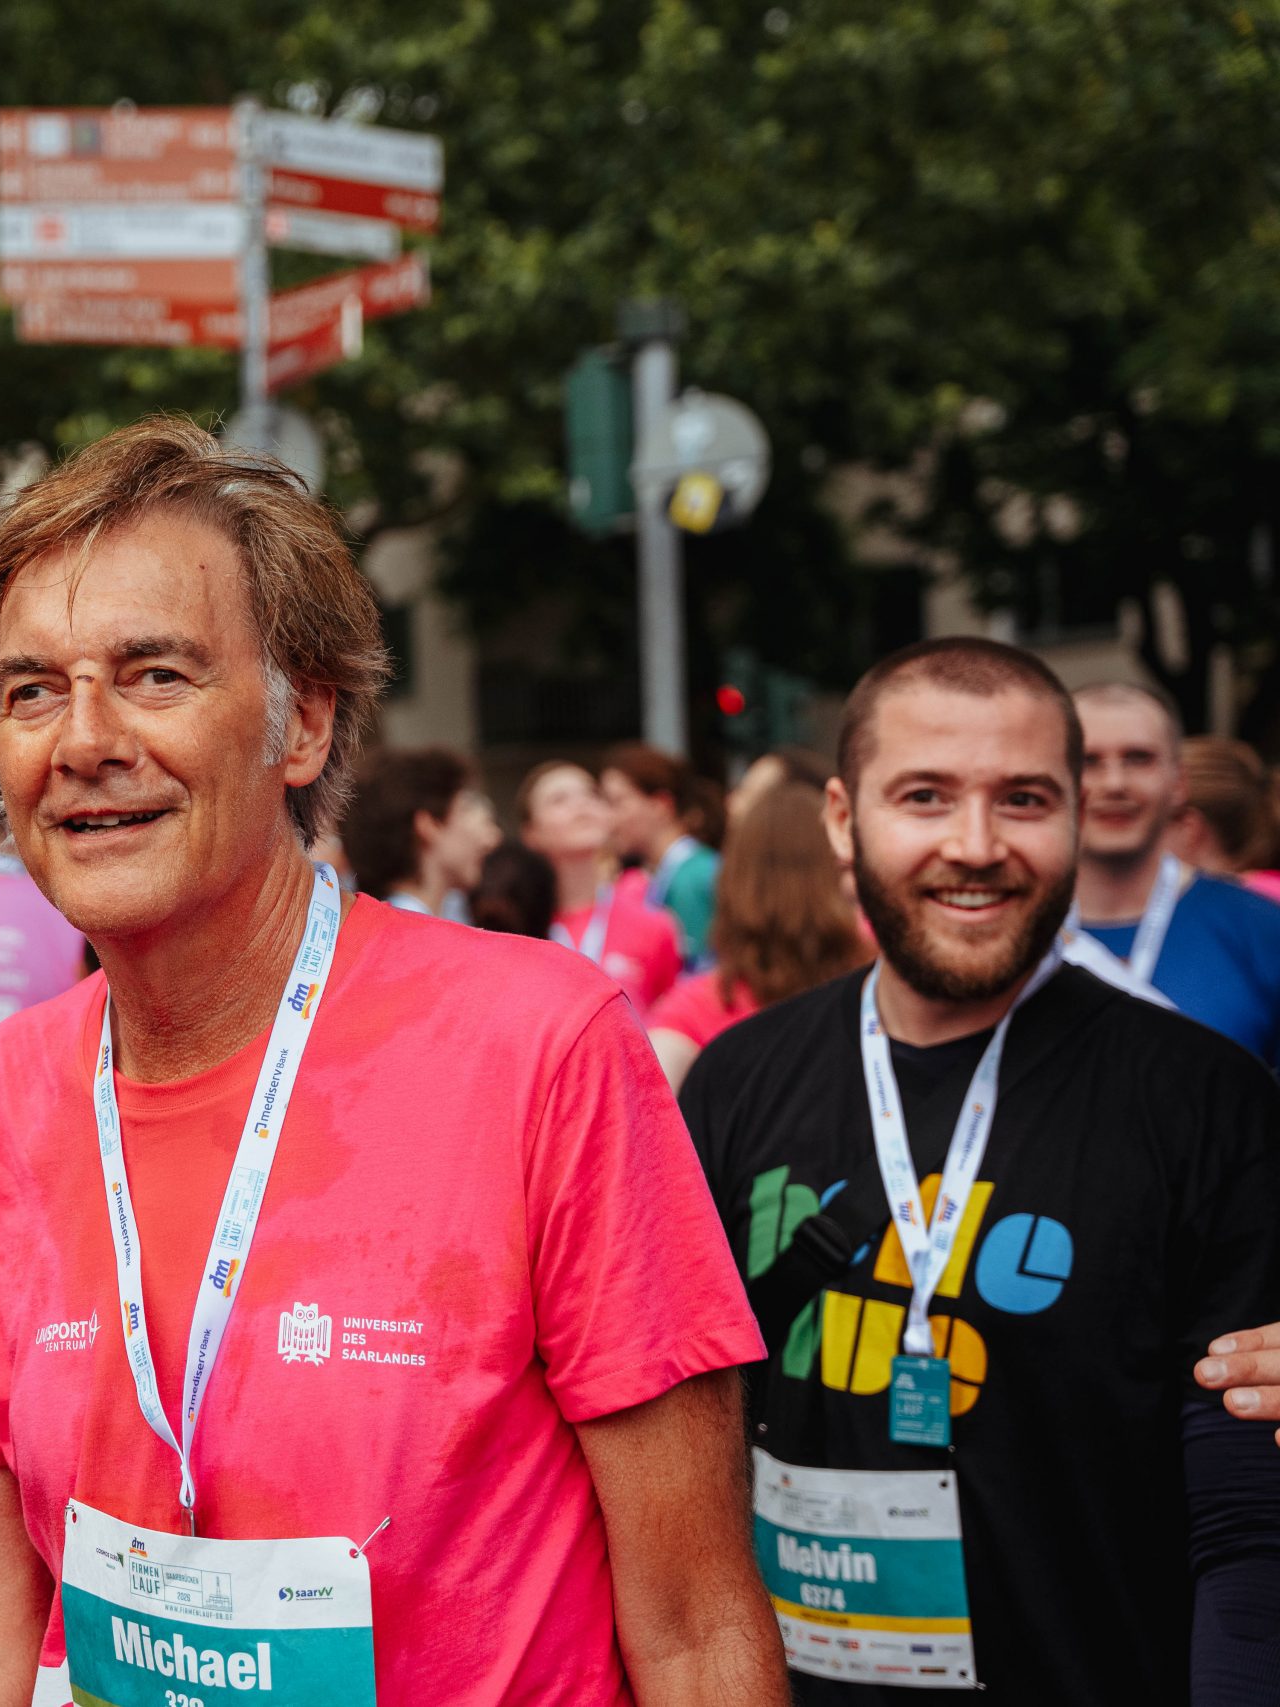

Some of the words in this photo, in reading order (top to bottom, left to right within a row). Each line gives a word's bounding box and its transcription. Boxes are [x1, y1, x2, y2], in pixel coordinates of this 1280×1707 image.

[309, 949, 322, 973] LAUF
[288, 983, 309, 1011] dm
[261, 1070, 282, 1121] mediserv
[277, 1048, 289, 1069] Bank
[116, 1197, 130, 1246] mediserv
[228, 1223, 242, 1247] LAUF
[209, 1259, 230, 1289] dm
[129, 1302, 140, 1330] dm
[343, 1317, 423, 1334] UNIVERSITÄT
[45, 1340, 86, 1352] ZENTRUM
[342, 1333, 366, 1345] DES
[133, 1344, 144, 1368] LAUF
[191, 1351, 206, 1406] mediserv
[200, 1328, 212, 1350] Bank
[342, 1348, 426, 1367] SAARLANDES
[132, 1537, 145, 1551] dm
[131, 1561, 159, 1579] FIRMEN
[777, 1533, 877, 1583] Melvin
[132, 1575, 160, 1595] LAUF
[112, 1615, 272, 1690] Michael
